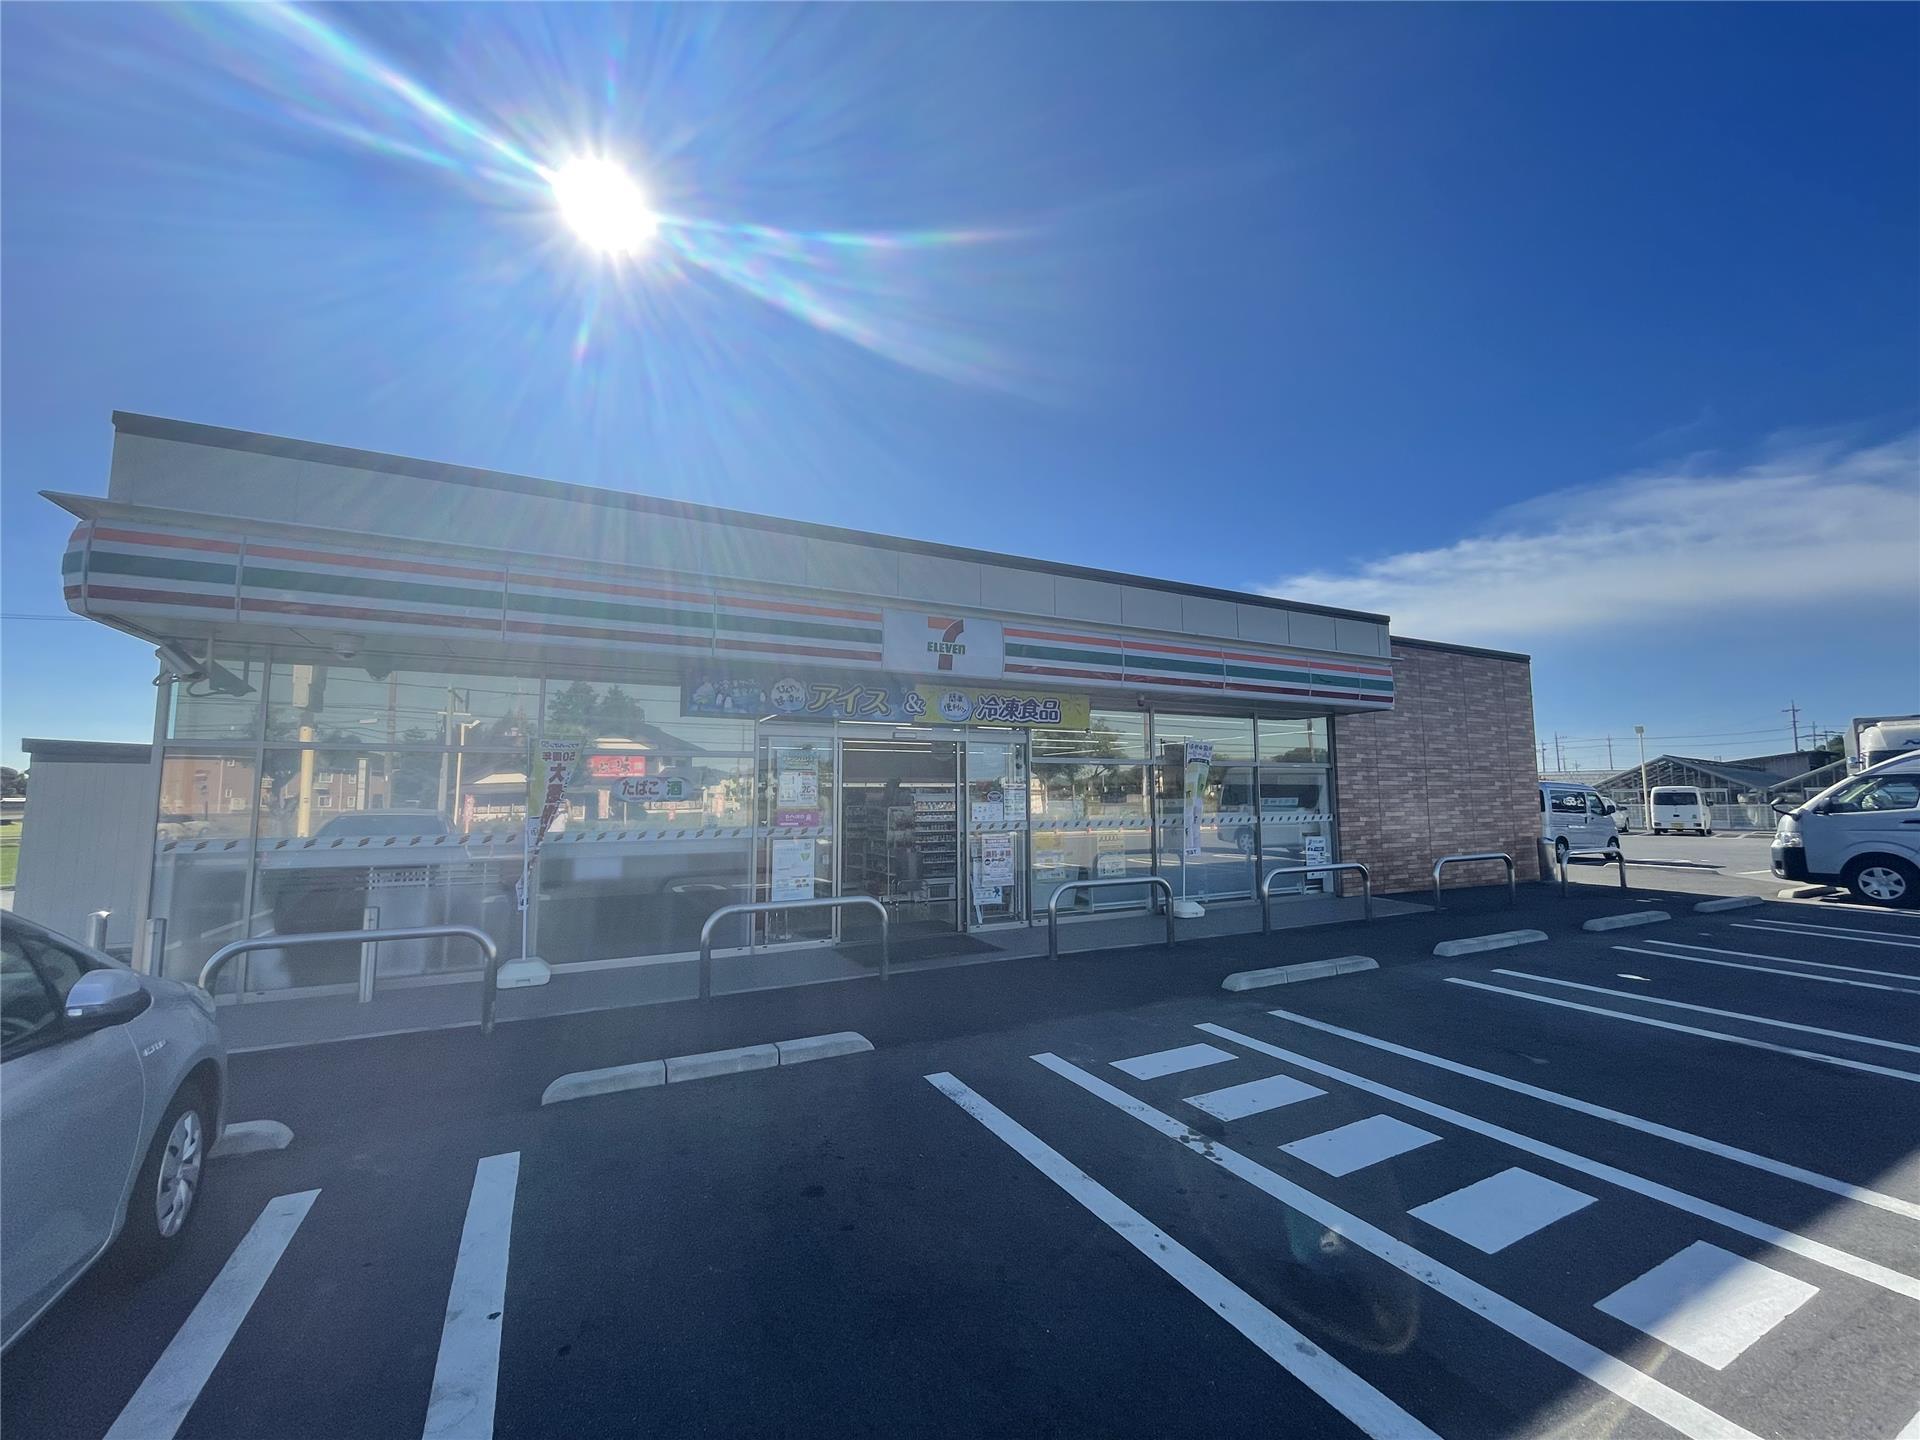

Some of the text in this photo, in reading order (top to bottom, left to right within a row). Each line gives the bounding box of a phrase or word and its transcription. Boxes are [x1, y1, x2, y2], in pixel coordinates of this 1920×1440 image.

[808, 682, 926, 716] アイス &
[977, 695, 1061, 722] 冷凍食品
[622, 780, 683, 796] たばこ 酒
